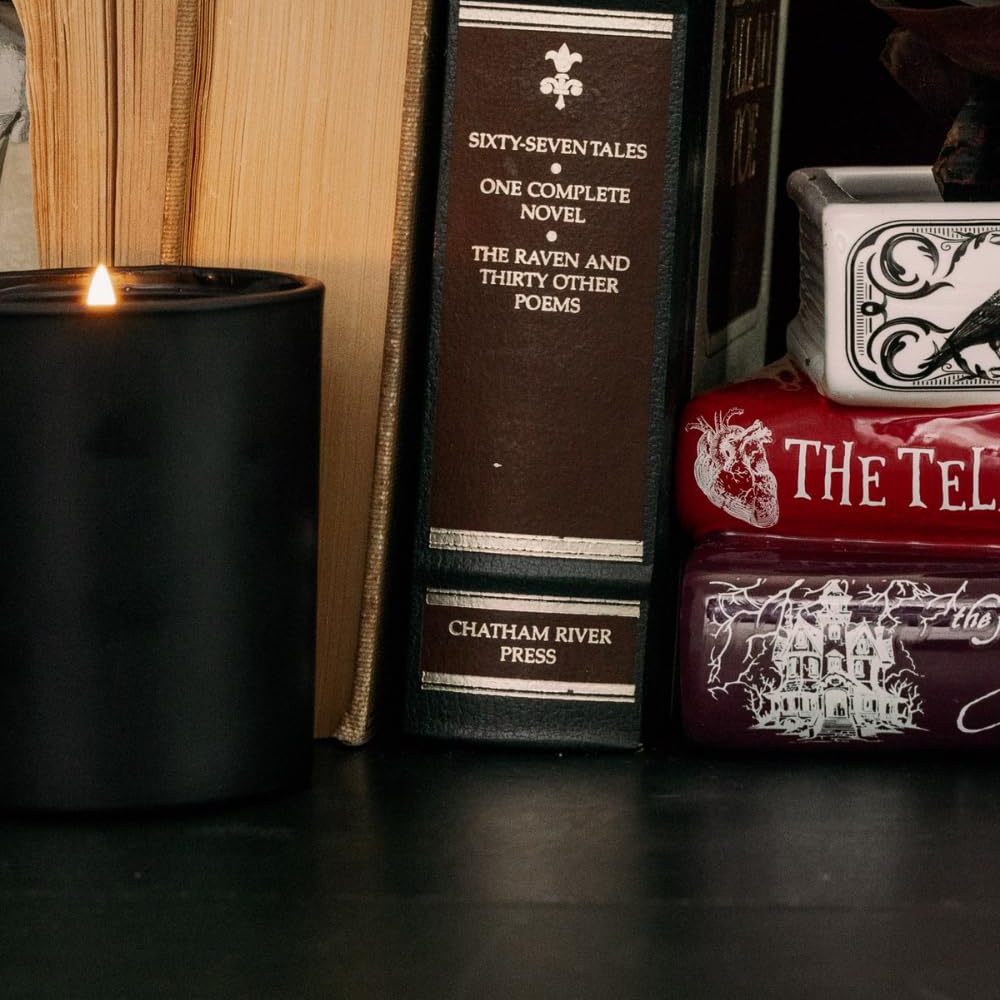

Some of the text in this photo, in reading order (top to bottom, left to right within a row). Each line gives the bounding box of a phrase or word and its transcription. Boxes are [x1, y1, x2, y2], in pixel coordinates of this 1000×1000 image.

[468, 132, 648, 160] SIXTY-SEVEN TALES
[479, 177, 631, 204] ONE COMPLETE
[520, 203, 586, 224] NOVEL
[471, 245, 631, 272] THE RAVEN AND
[479, 268, 619, 294] THIRTY OTHER
[514, 293, 581, 314] POEMS
[784, 438, 886, 507] THE
[448, 619, 613, 645] CHATHAM RIVER
[499, 646, 557, 665] PRESS
